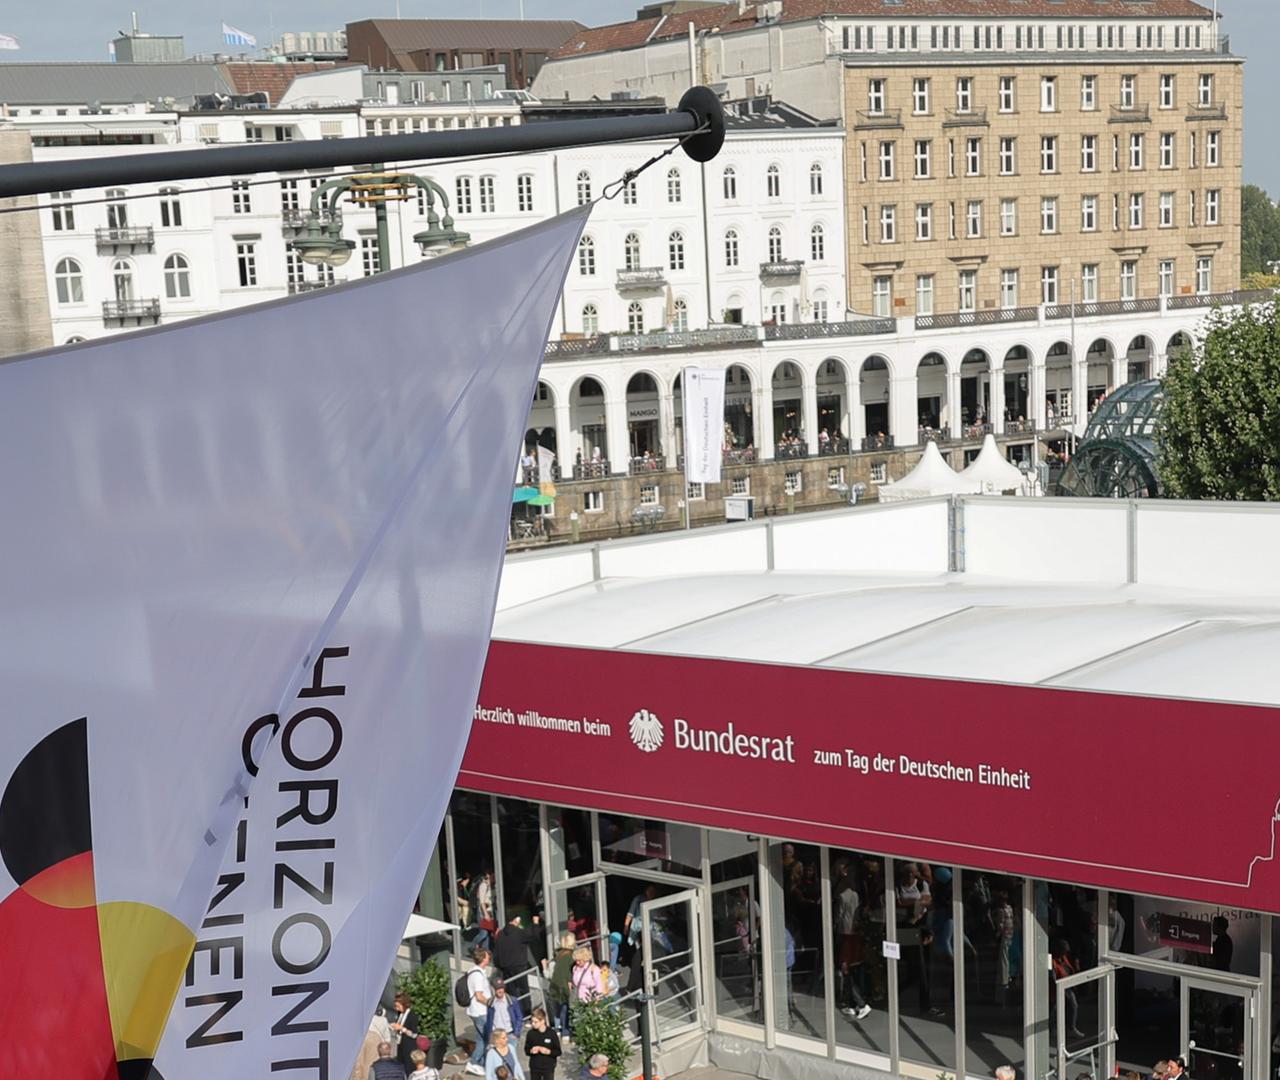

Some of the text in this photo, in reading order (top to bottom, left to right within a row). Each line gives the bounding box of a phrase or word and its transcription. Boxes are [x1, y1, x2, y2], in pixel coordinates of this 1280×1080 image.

[474, 704, 1032, 790] Herzlich willkommen beim Bundesrat zum Tag der Deutschen Einheit
